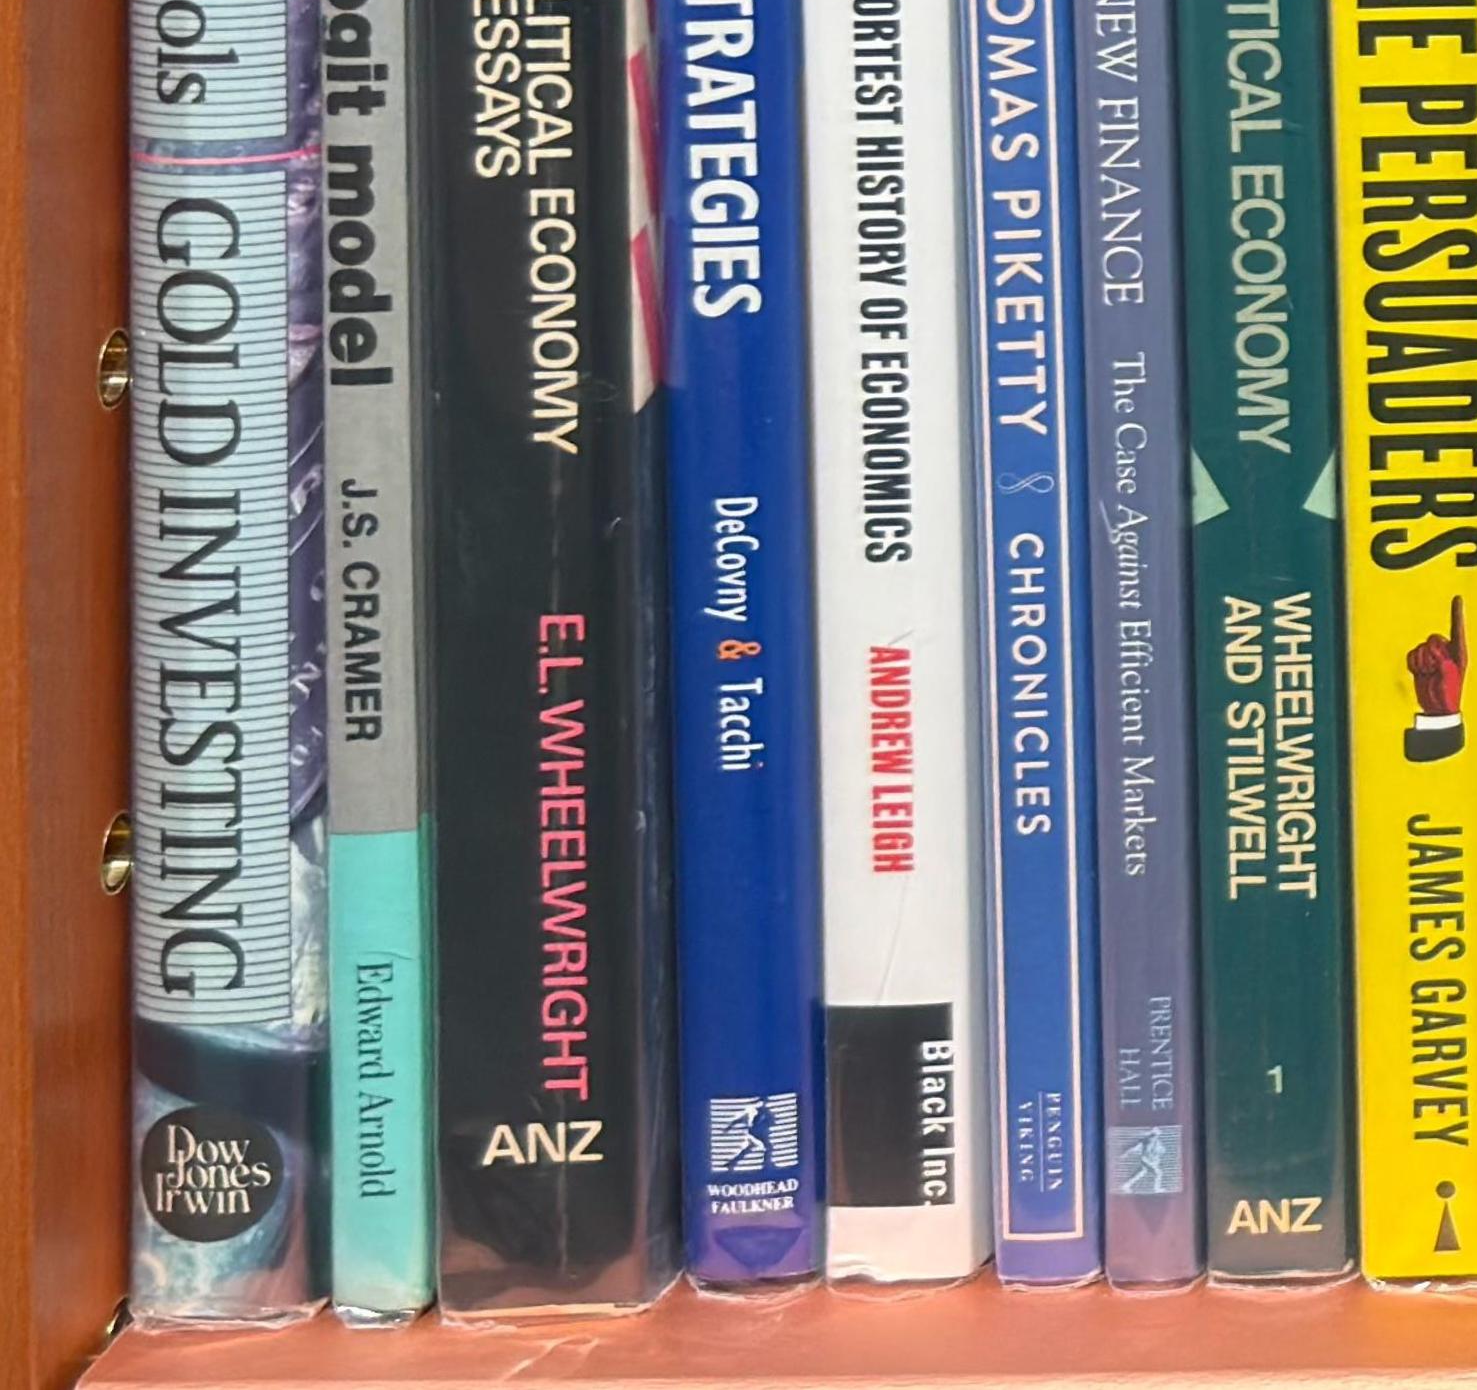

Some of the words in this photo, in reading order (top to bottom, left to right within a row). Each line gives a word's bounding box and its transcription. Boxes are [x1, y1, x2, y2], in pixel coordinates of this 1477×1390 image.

[1097, 97, 1144, 305] FINANCE
[327, 145, 394, 385] model
[993, 190, 1048, 435] PIKETTY
[157, 197, 241, 466] GOLD
[529, 188, 579, 455] ECONOMY
[1112, 352, 1146, 413] The
[1114, 424, 1148, 494] Case
[341, 478, 378, 549] J.S.
[706, 497, 759, 622] DeCovny
[1110, 503, 1149, 610] Against
[342, 561, 381, 742] CRAMER
[715, 641, 761, 659] &
[1007, 532, 1051, 838] CHRONICLES
[1120, 618, 1154, 746] Efficient
[1223, 596, 1263, 684] AND
[157, 490, 246, 997] INVESTING
[718, 678, 763, 771] Tacchi
[869, 646, 914, 776] ANDREW
[1273, 592, 1317, 900] WHEELWRIGHT
[871, 782, 915, 873] LEIGH
[1122, 757, 1156, 877] Markets
[1226, 701, 1267, 900] STILWELL
[1406, 813, 1466, 963] JAMES
[355, 961, 394, 1079] Edward
[1150, 996, 1174, 1110] PRENTICE
[1410, 978, 1469, 1147] GARVEY
[920, 1040, 954, 1137] Black
[1120, 1048, 1141, 1110] HALL
[157, 1175, 251, 1214] Irwin
[168, 1125, 250, 1164] Dow
[174, 1155, 271, 1188] Jones
[359, 1092, 396, 1200] Arnold
[482, 1121, 603, 1166] ANZ
[708, 1179, 799, 1198] WOODHEAD
[920, 1148, 954, 1207] Inc.
[1019, 1103, 1034, 1183] VIKING
[1045, 1091, 1062, 1192] PENGUIN
[711, 1196, 794, 1214] FAULKNER
[1227, 1197, 1323, 1235] ANZ
